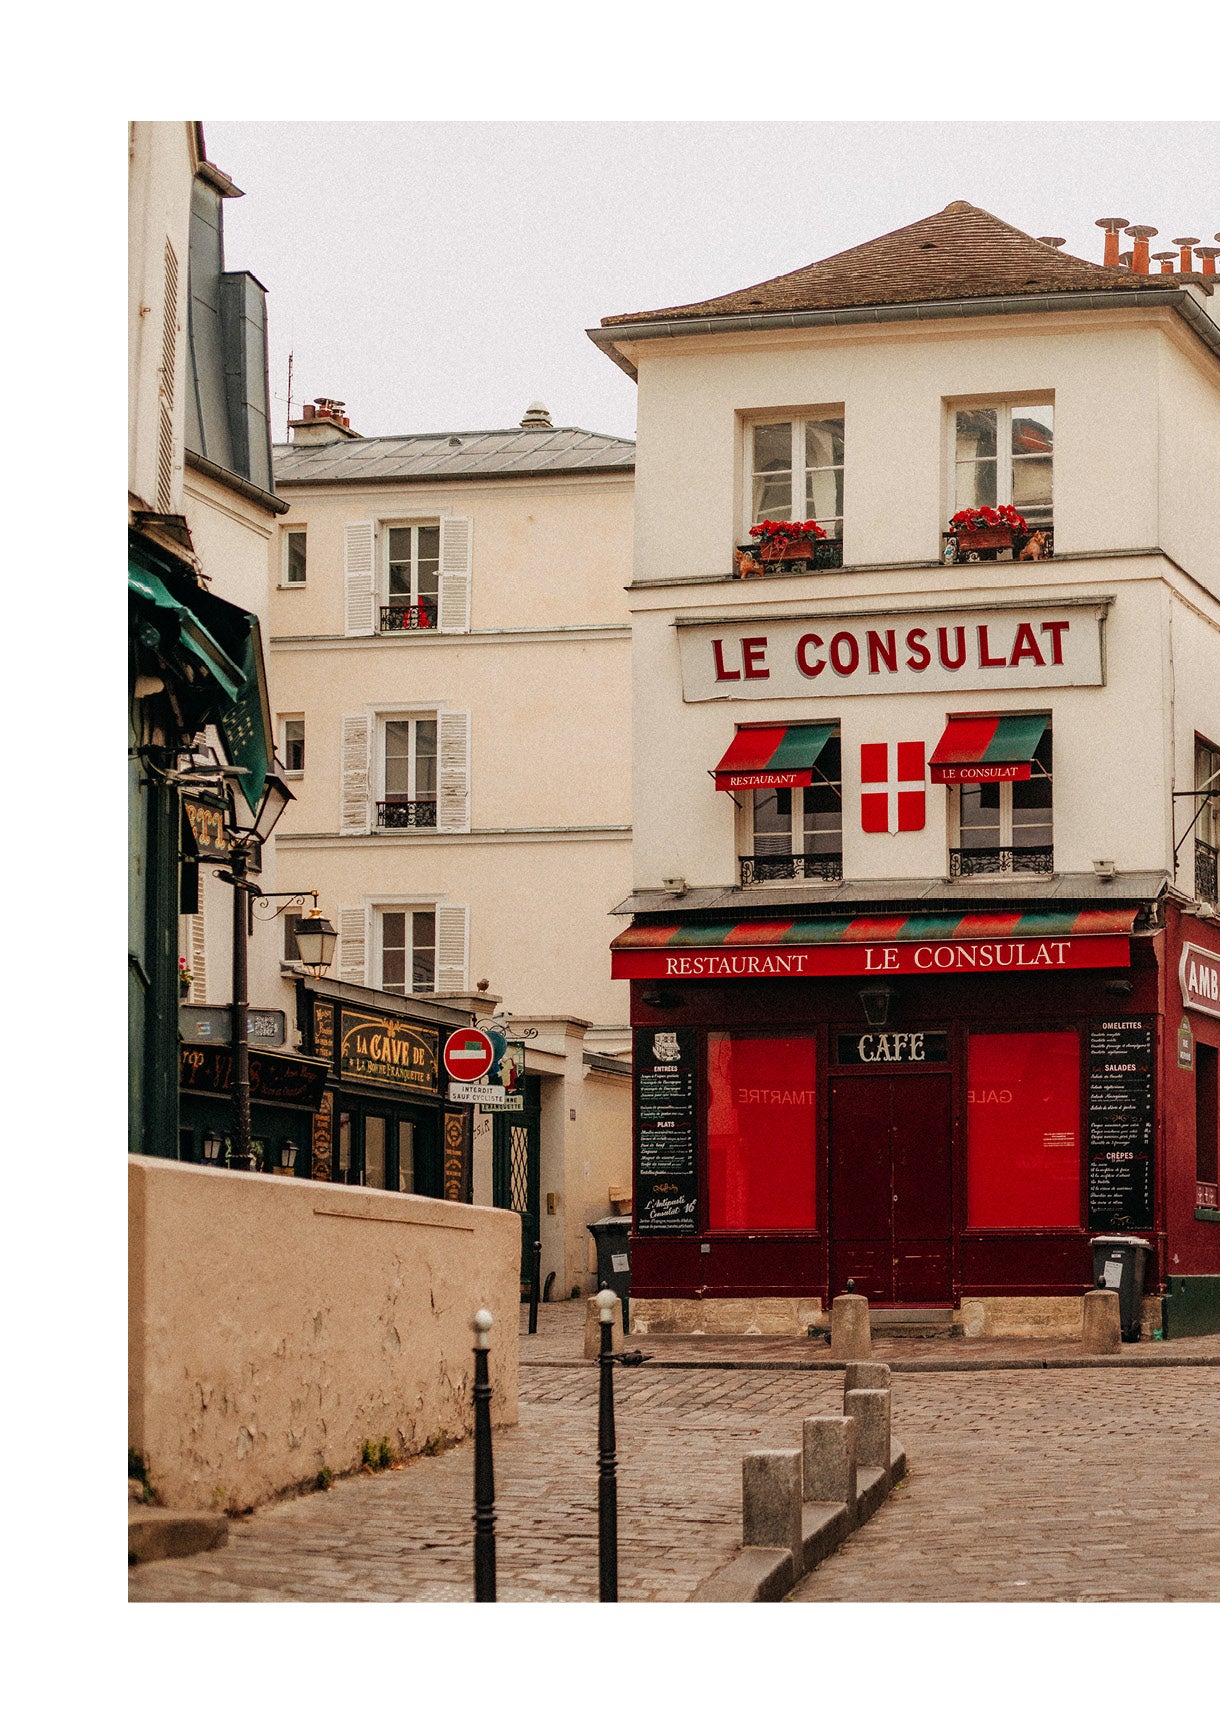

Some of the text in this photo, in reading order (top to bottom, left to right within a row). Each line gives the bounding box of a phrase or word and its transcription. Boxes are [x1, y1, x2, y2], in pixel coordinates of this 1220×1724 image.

[711, 621, 1070, 682] LE CONSULAT
[942, 766, 1018, 780] LE CONSULAT
[729, 774, 797, 786] RESTAURANT
[665, 941, 1072, 976] RESTAURANT LE CONSULAT
[1102, 1022, 1142, 1030] OMELETTES
[356, 1035, 425, 1066] LA CAVE DE
[1104, 1064, 1137, 1072] SALADES
[462, 1086, 493, 1094] INTERDIT
[1106, 1151, 1134, 1160] CRÊPES
